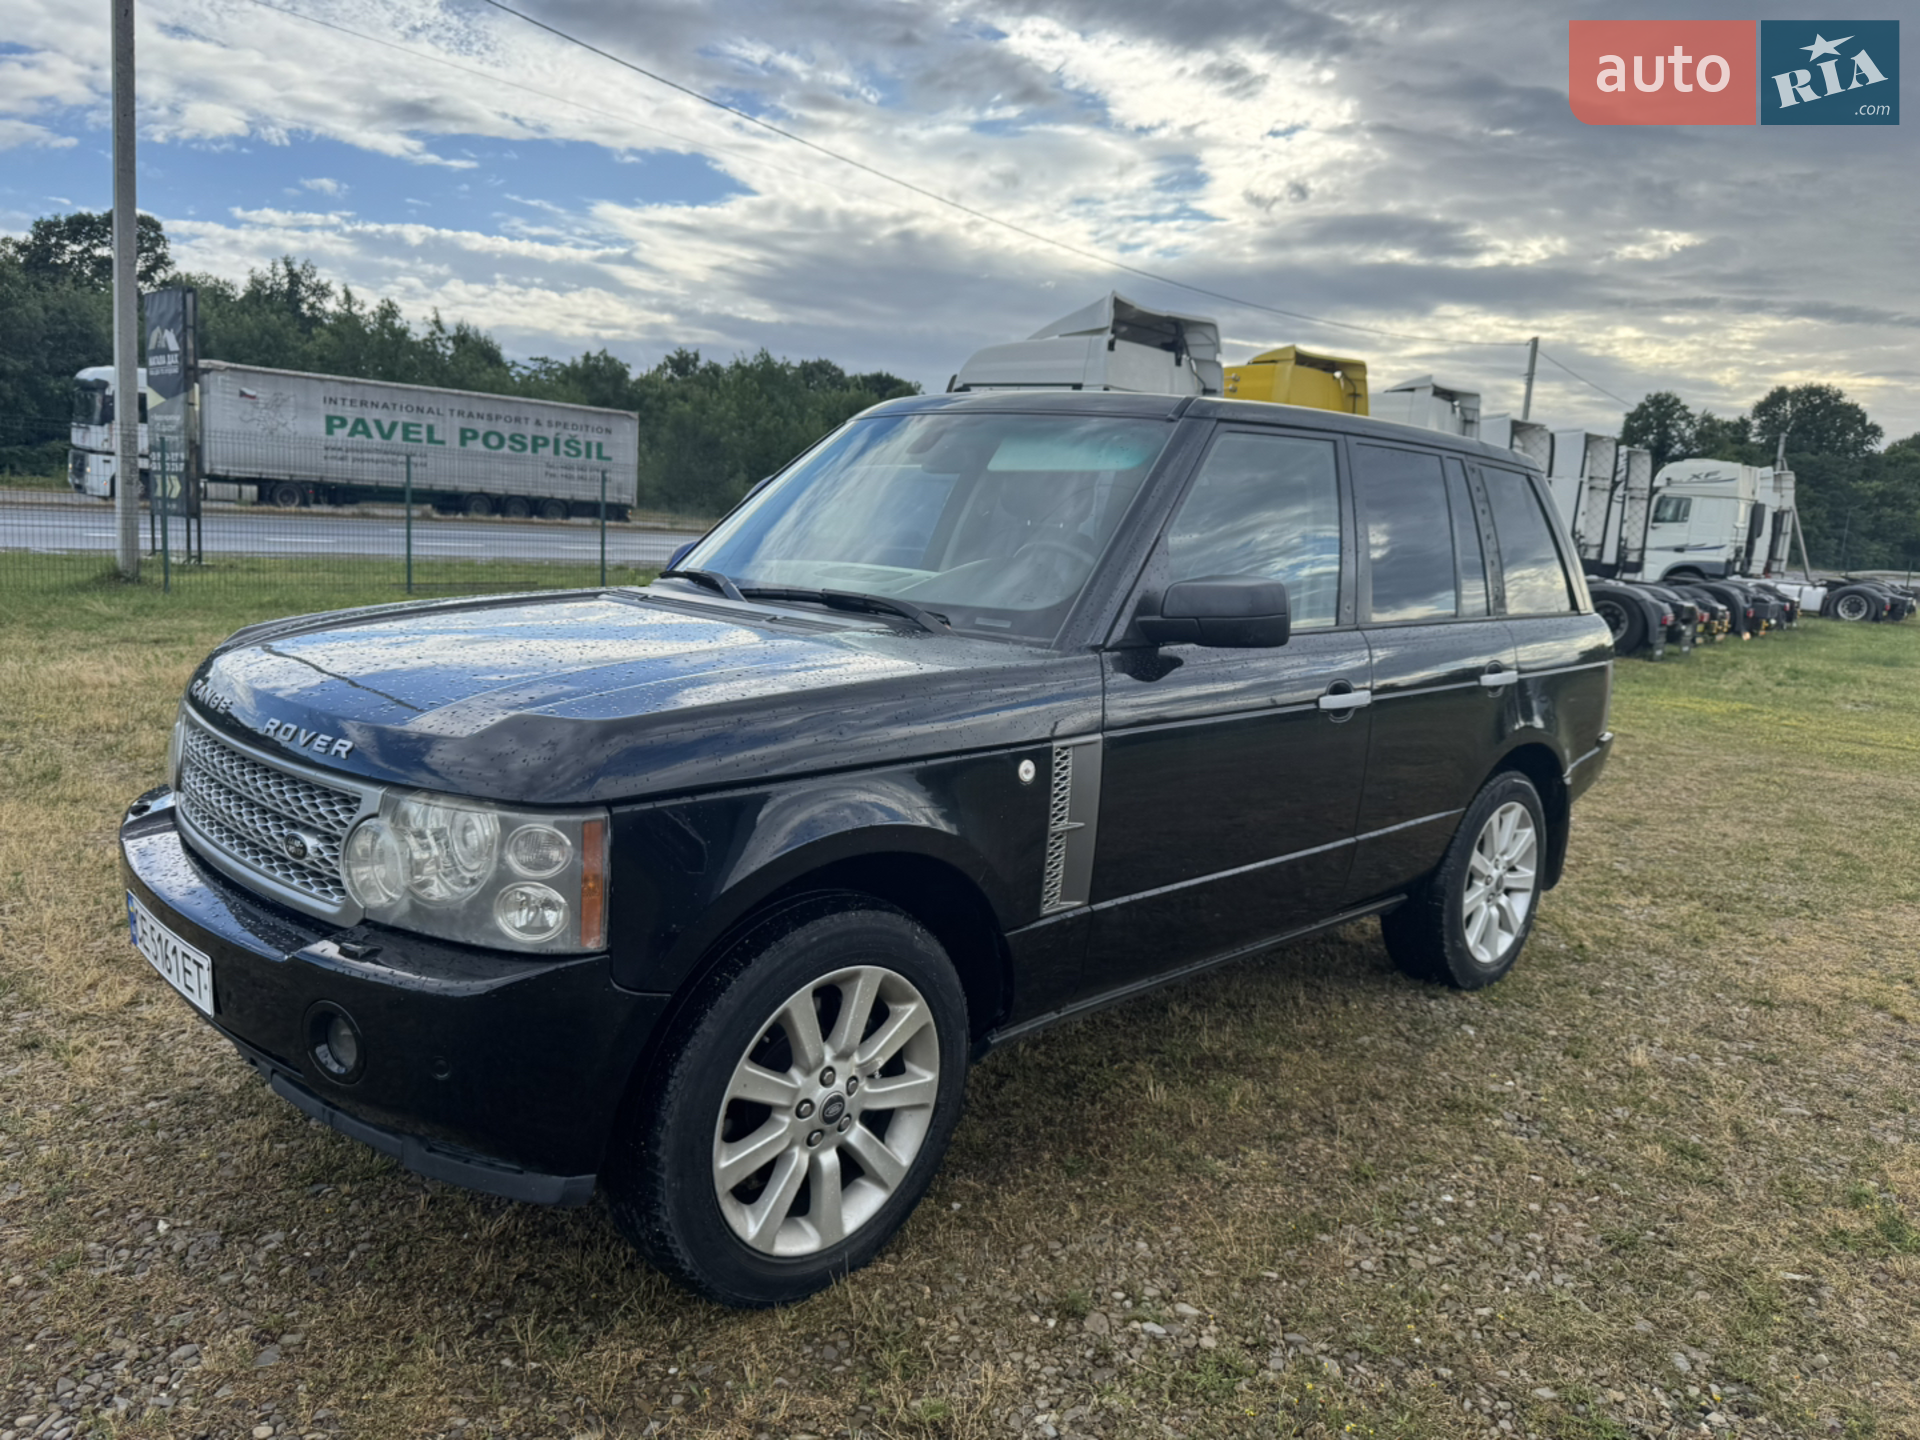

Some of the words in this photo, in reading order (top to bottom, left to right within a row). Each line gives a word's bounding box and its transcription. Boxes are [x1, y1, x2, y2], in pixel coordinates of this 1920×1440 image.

[323, 396, 445, 417] INTERNATIONAL
[449, 408, 531, 426] TRANSPORT
[535, 416, 543, 427] &
[547, 419, 613, 435] SPEDITION
[325, 414, 446, 446] PAVEL
[459, 427, 613, 462] POSPÍŠIL
[190, 679, 232, 715] RANGE
[263, 717, 355, 760] ROVER
